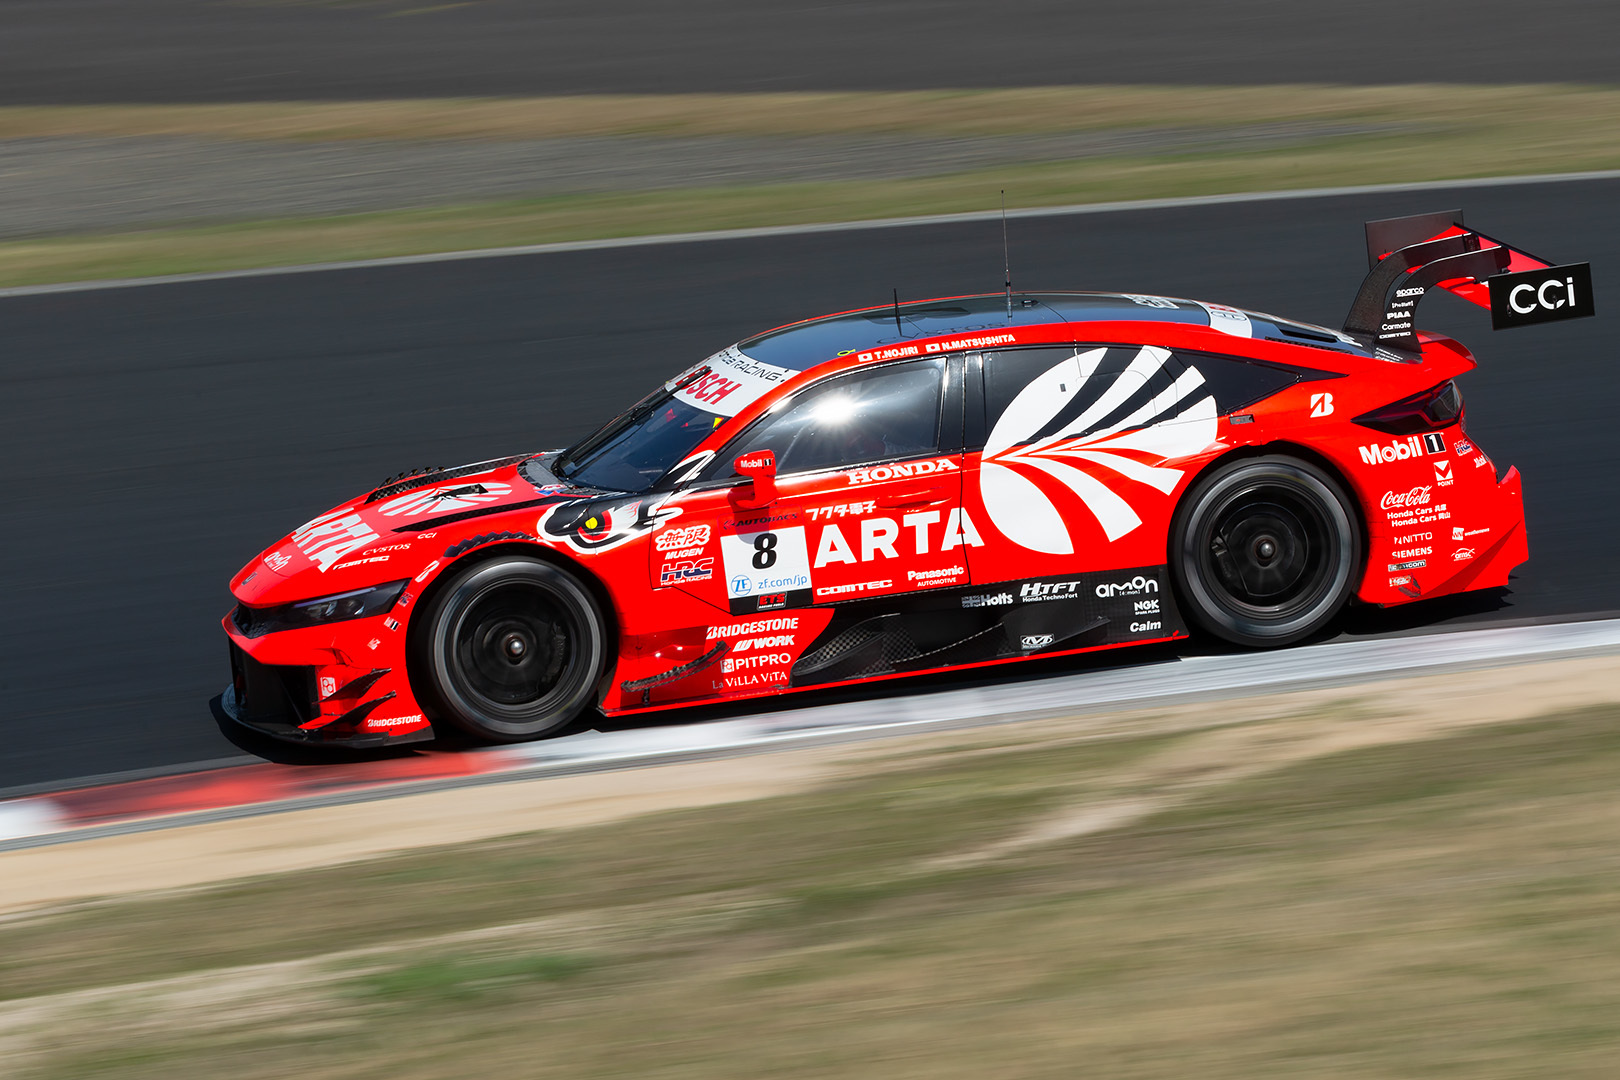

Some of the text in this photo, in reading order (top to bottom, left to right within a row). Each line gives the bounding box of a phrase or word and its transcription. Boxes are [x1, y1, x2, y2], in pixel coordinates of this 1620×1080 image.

[1396, 287, 1424, 297] sparco
[1386, 311, 1411, 320] PIAA
[1381, 322, 1411, 331] Carmate
[942, 334, 1016, 350] N.MATSUSHITA
[874, 346, 918, 360] T.NOJIRI
[1358, 436, 1423, 465] Mobil
[741, 459, 762, 468] Mobil
[848, 458, 959, 485] HONDA
[1380, 485, 1432, 510] Coca-Cola
[1387, 510, 1413, 520] Honda
[1415, 507, 1432, 515] Cars
[1391, 518, 1418, 527] Honda
[1420, 515, 1437, 523] Cars
[813, 507, 985, 568] ARTA
[1403, 532, 1432, 543] NITTO
[362, 543, 411, 555] CVSTOS
[665, 547, 704, 560] MUGEN
[752, 532, 778, 570] 8
[1392, 546, 1433, 559] SIEMENS
[907, 565, 964, 581] Panasonic
[758, 574, 808, 590] zf.com/jp
[816, 579, 893, 596] COMTEC
[917, 577, 957, 587] AUTOMOTIVE
[1095, 576, 1159, 598] amon
[1020, 581, 1081, 598] HTFT
[759, 593, 786, 605] ETS
[981, 592, 1014, 606] Holts
[1133, 599, 1160, 611] NGK
[706, 618, 799, 640] BRIDGESTONE
[1130, 621, 1162, 633] Calm
[735, 653, 791, 671] PITPRO
[367, 714, 423, 728] BRIDGESTONE
